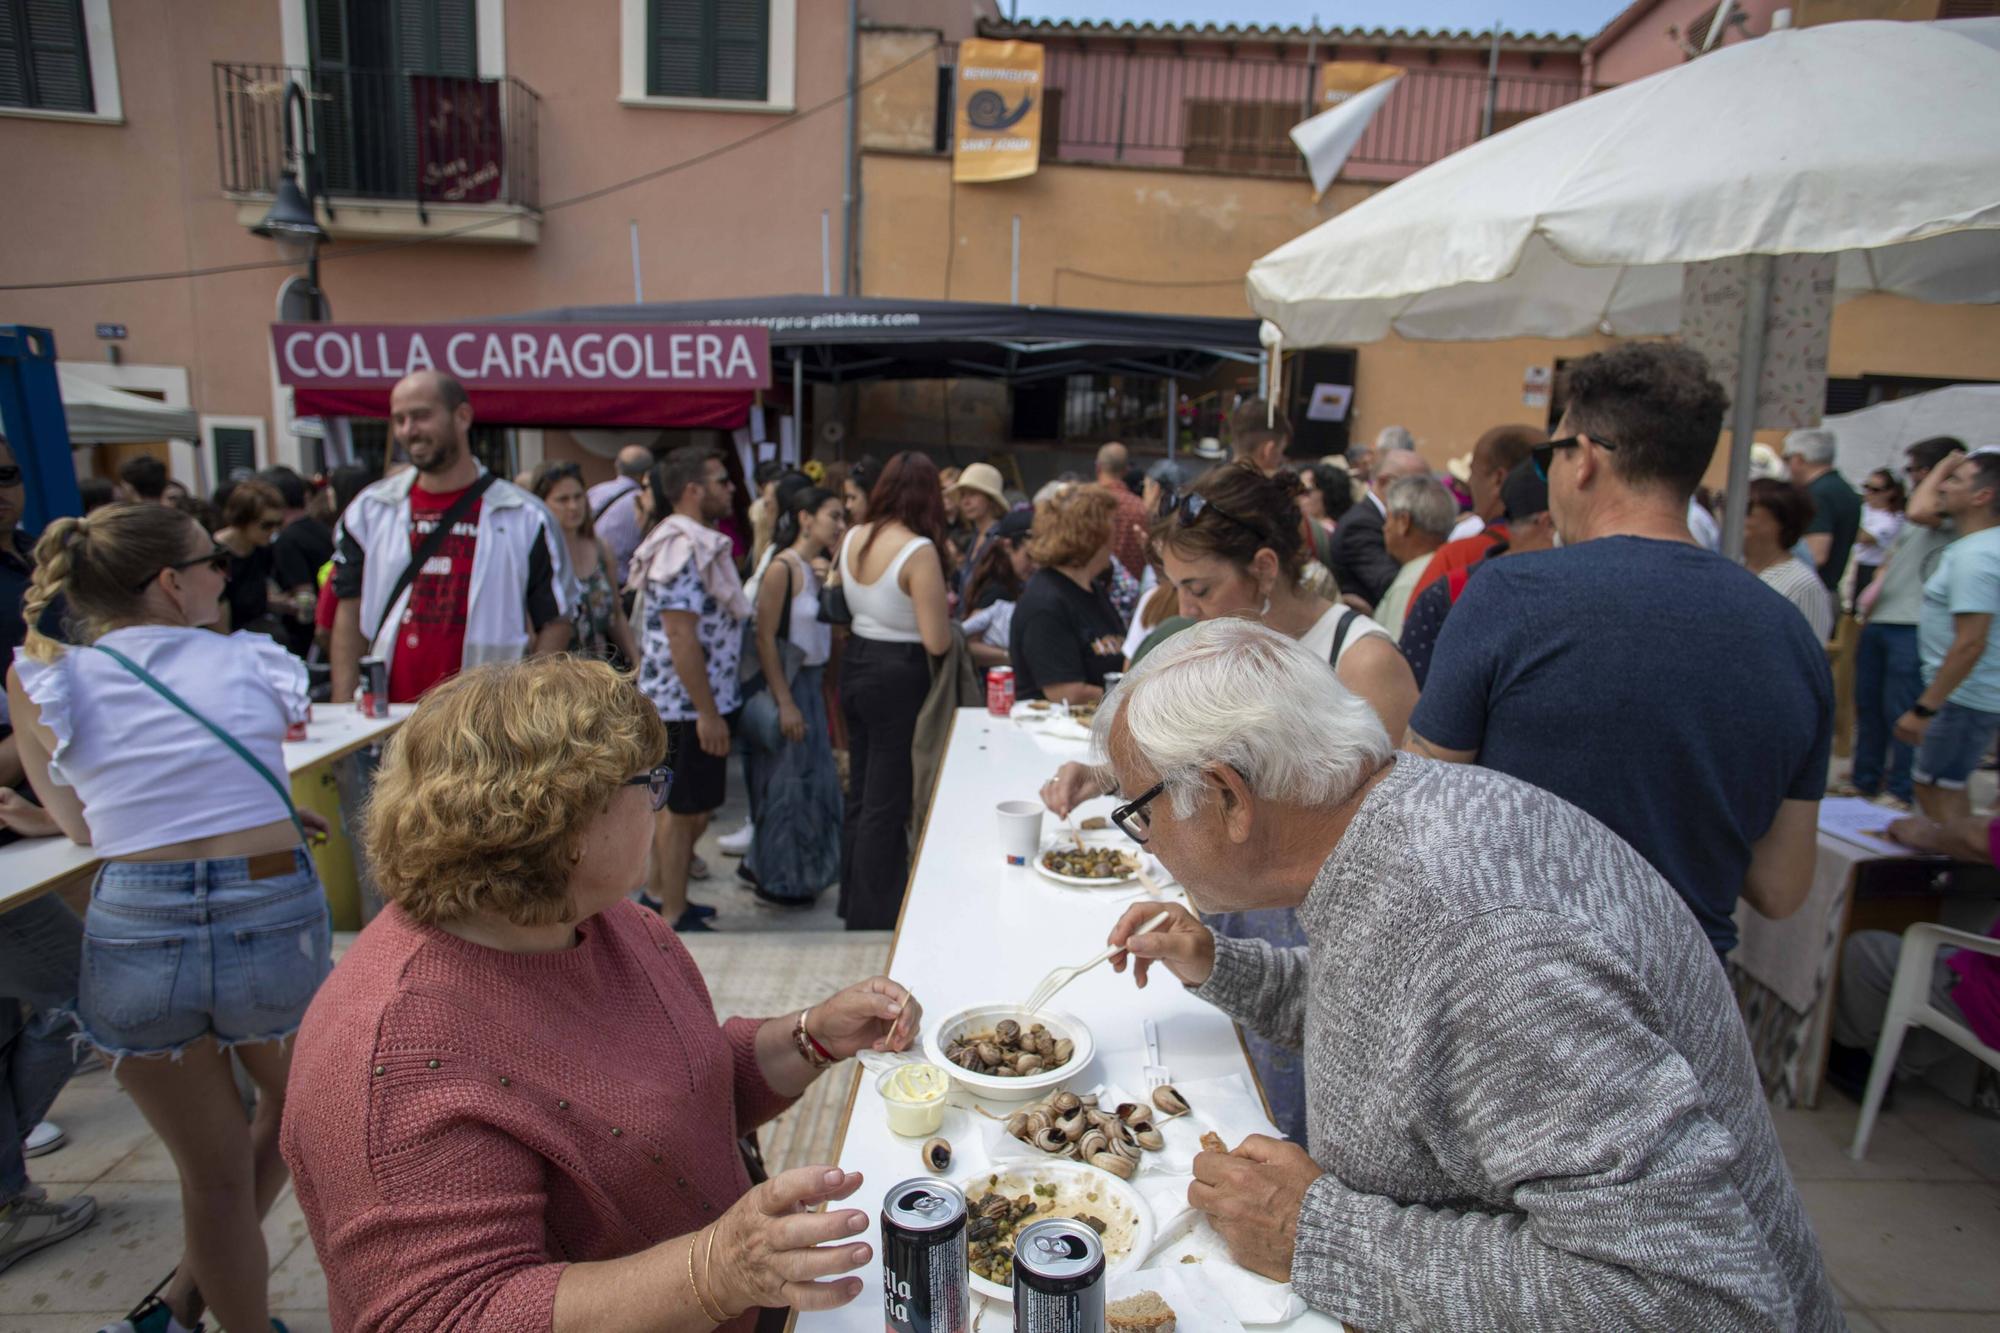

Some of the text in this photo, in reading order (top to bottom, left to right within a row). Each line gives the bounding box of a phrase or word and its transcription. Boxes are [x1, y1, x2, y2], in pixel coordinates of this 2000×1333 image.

[960, 138, 993, 152] SANT
[284, 331, 757, 380] COLLA CARAGOLERA
